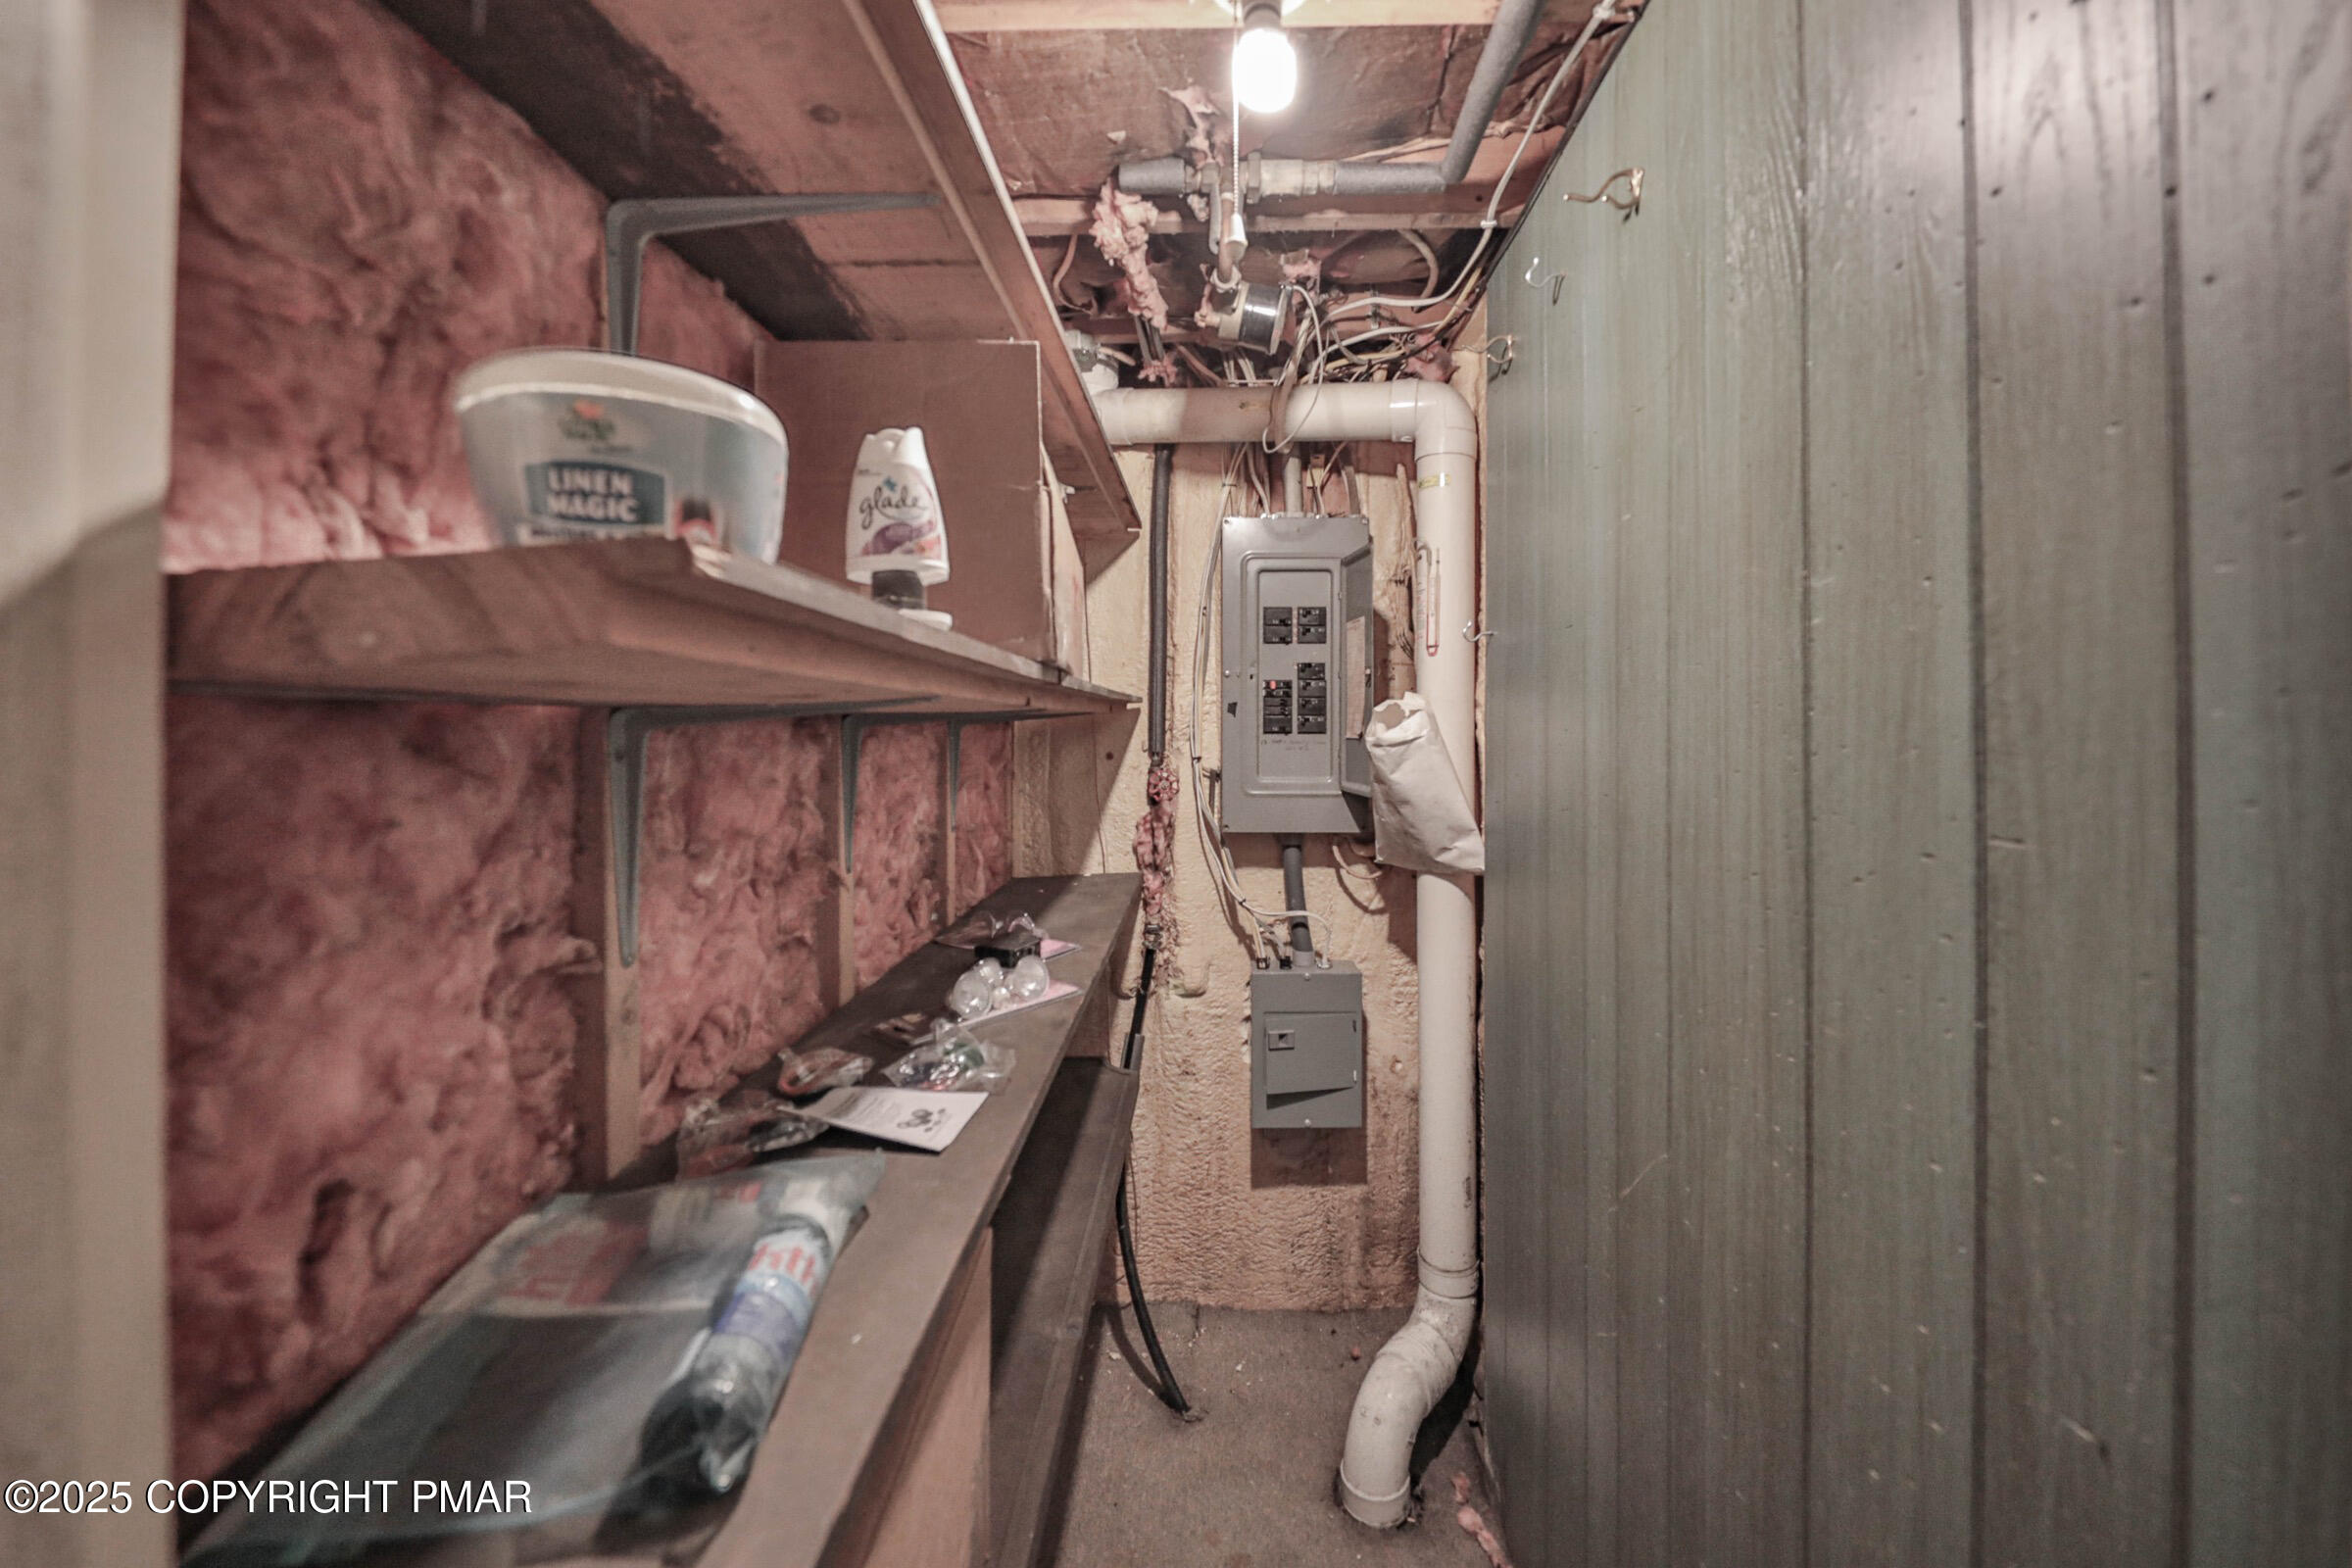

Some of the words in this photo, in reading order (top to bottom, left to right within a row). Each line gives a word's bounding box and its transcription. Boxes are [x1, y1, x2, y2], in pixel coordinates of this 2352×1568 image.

[548, 466, 634, 495] LINEN
[547, 492, 640, 522] MAGIC
[858, 485, 928, 530] glade
